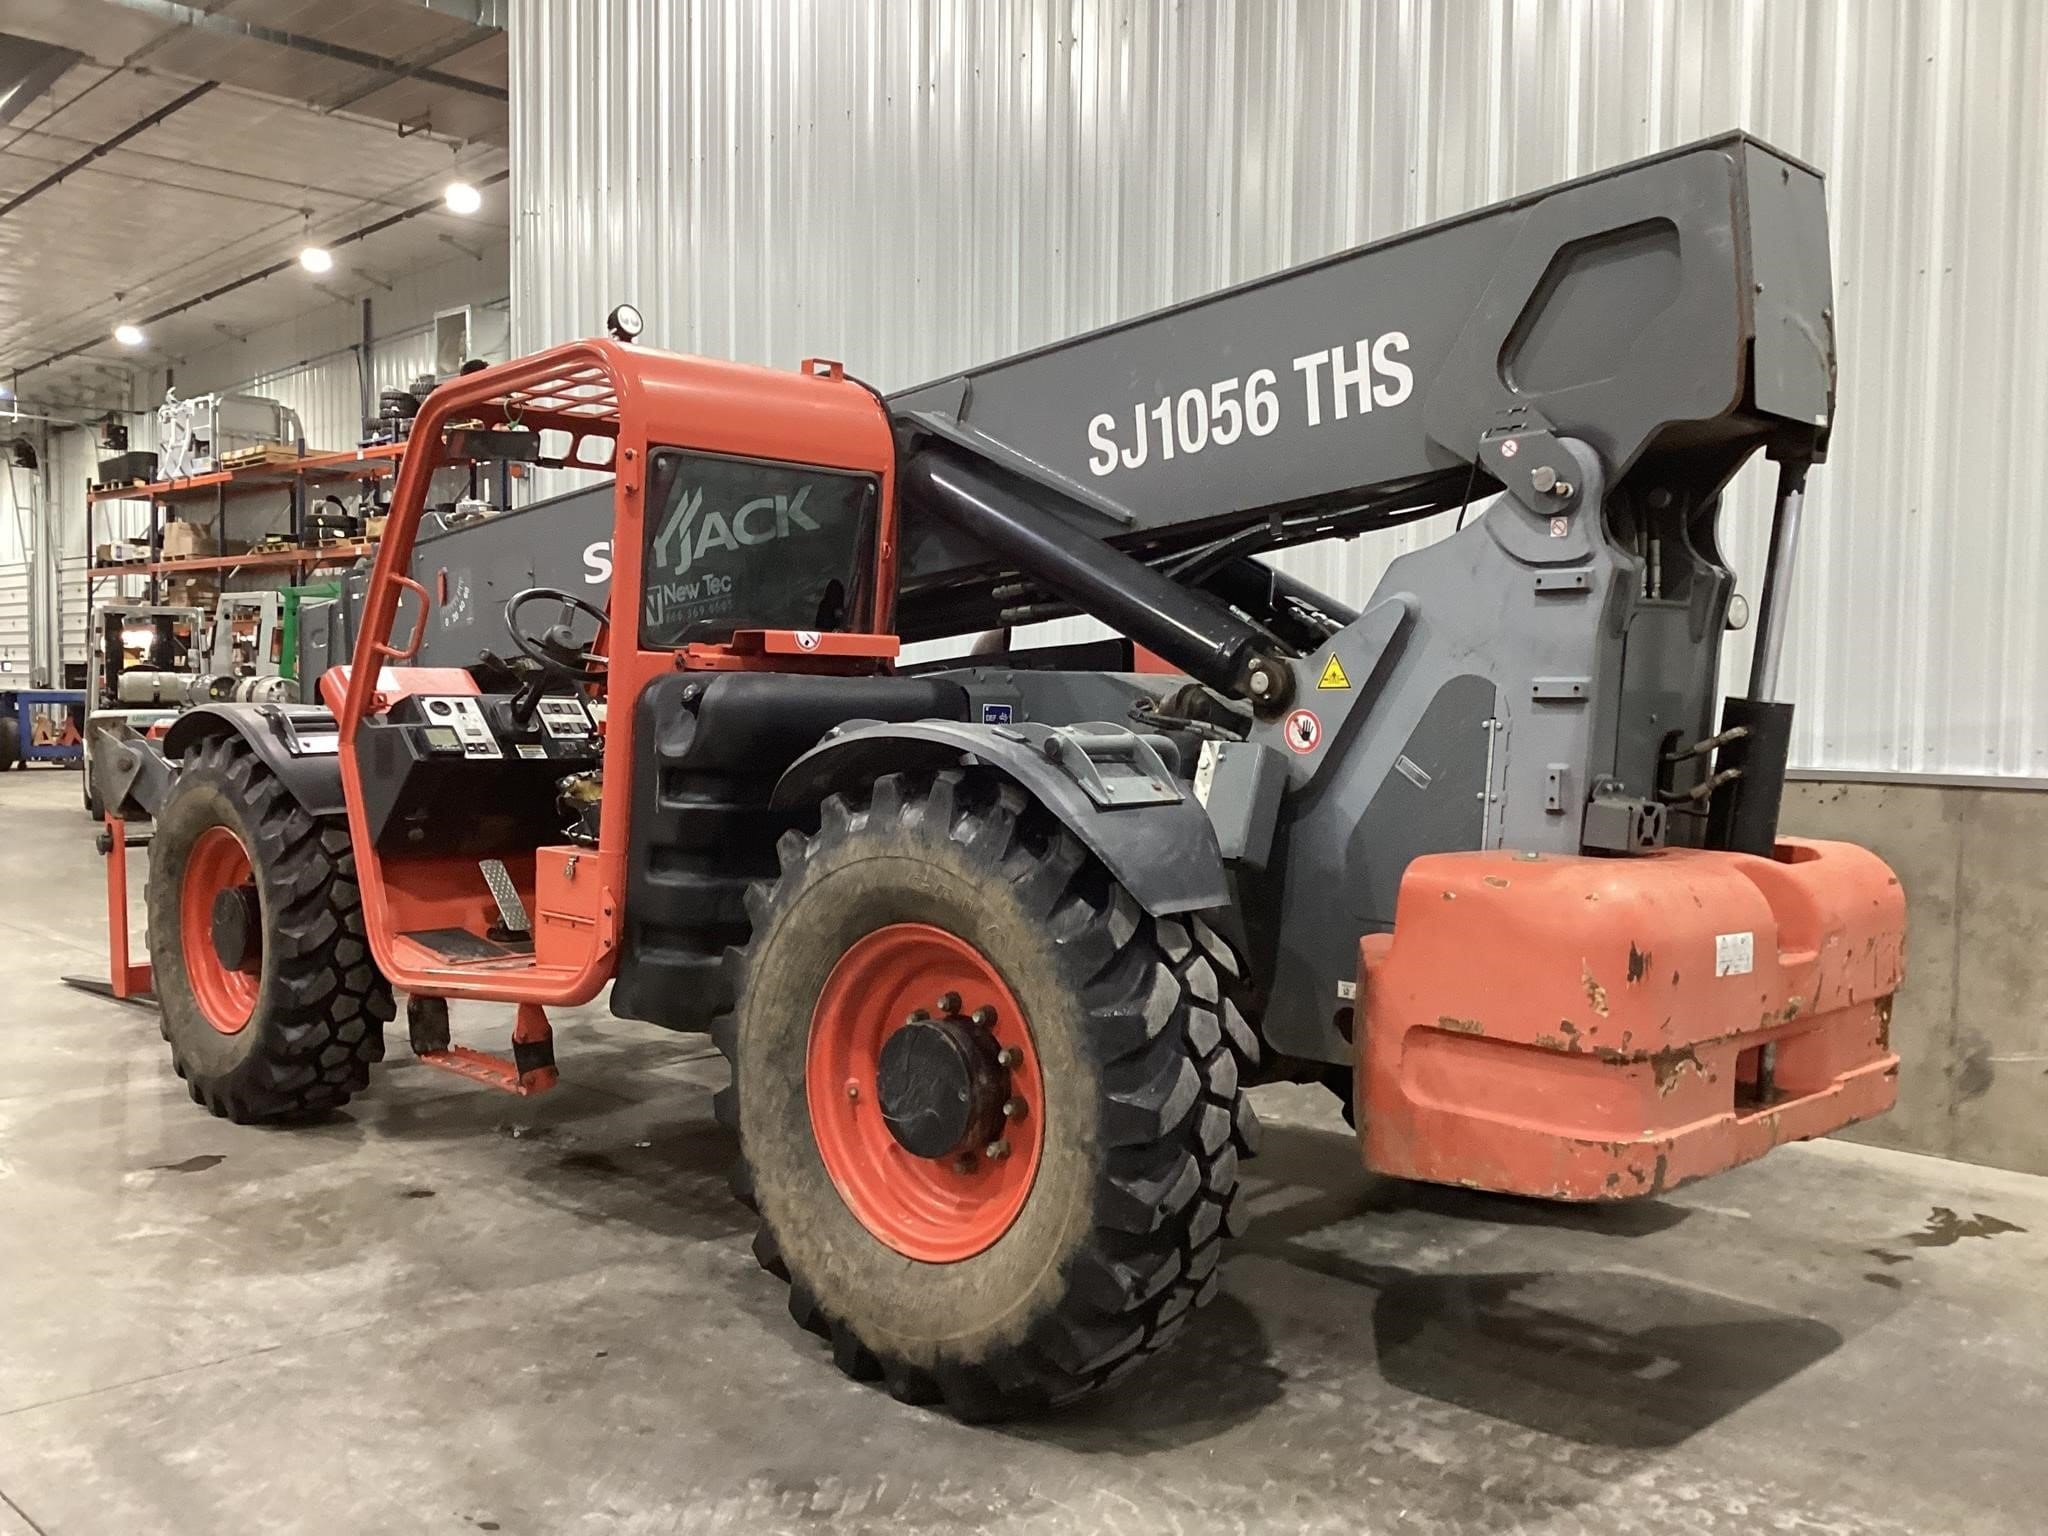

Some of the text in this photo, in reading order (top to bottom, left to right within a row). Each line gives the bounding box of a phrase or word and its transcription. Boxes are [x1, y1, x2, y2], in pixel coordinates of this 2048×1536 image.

[1087, 331, 1414, 476] SJ1056 THS
[663, 582, 700, 606] New
[702, 573, 732, 596] Tec
